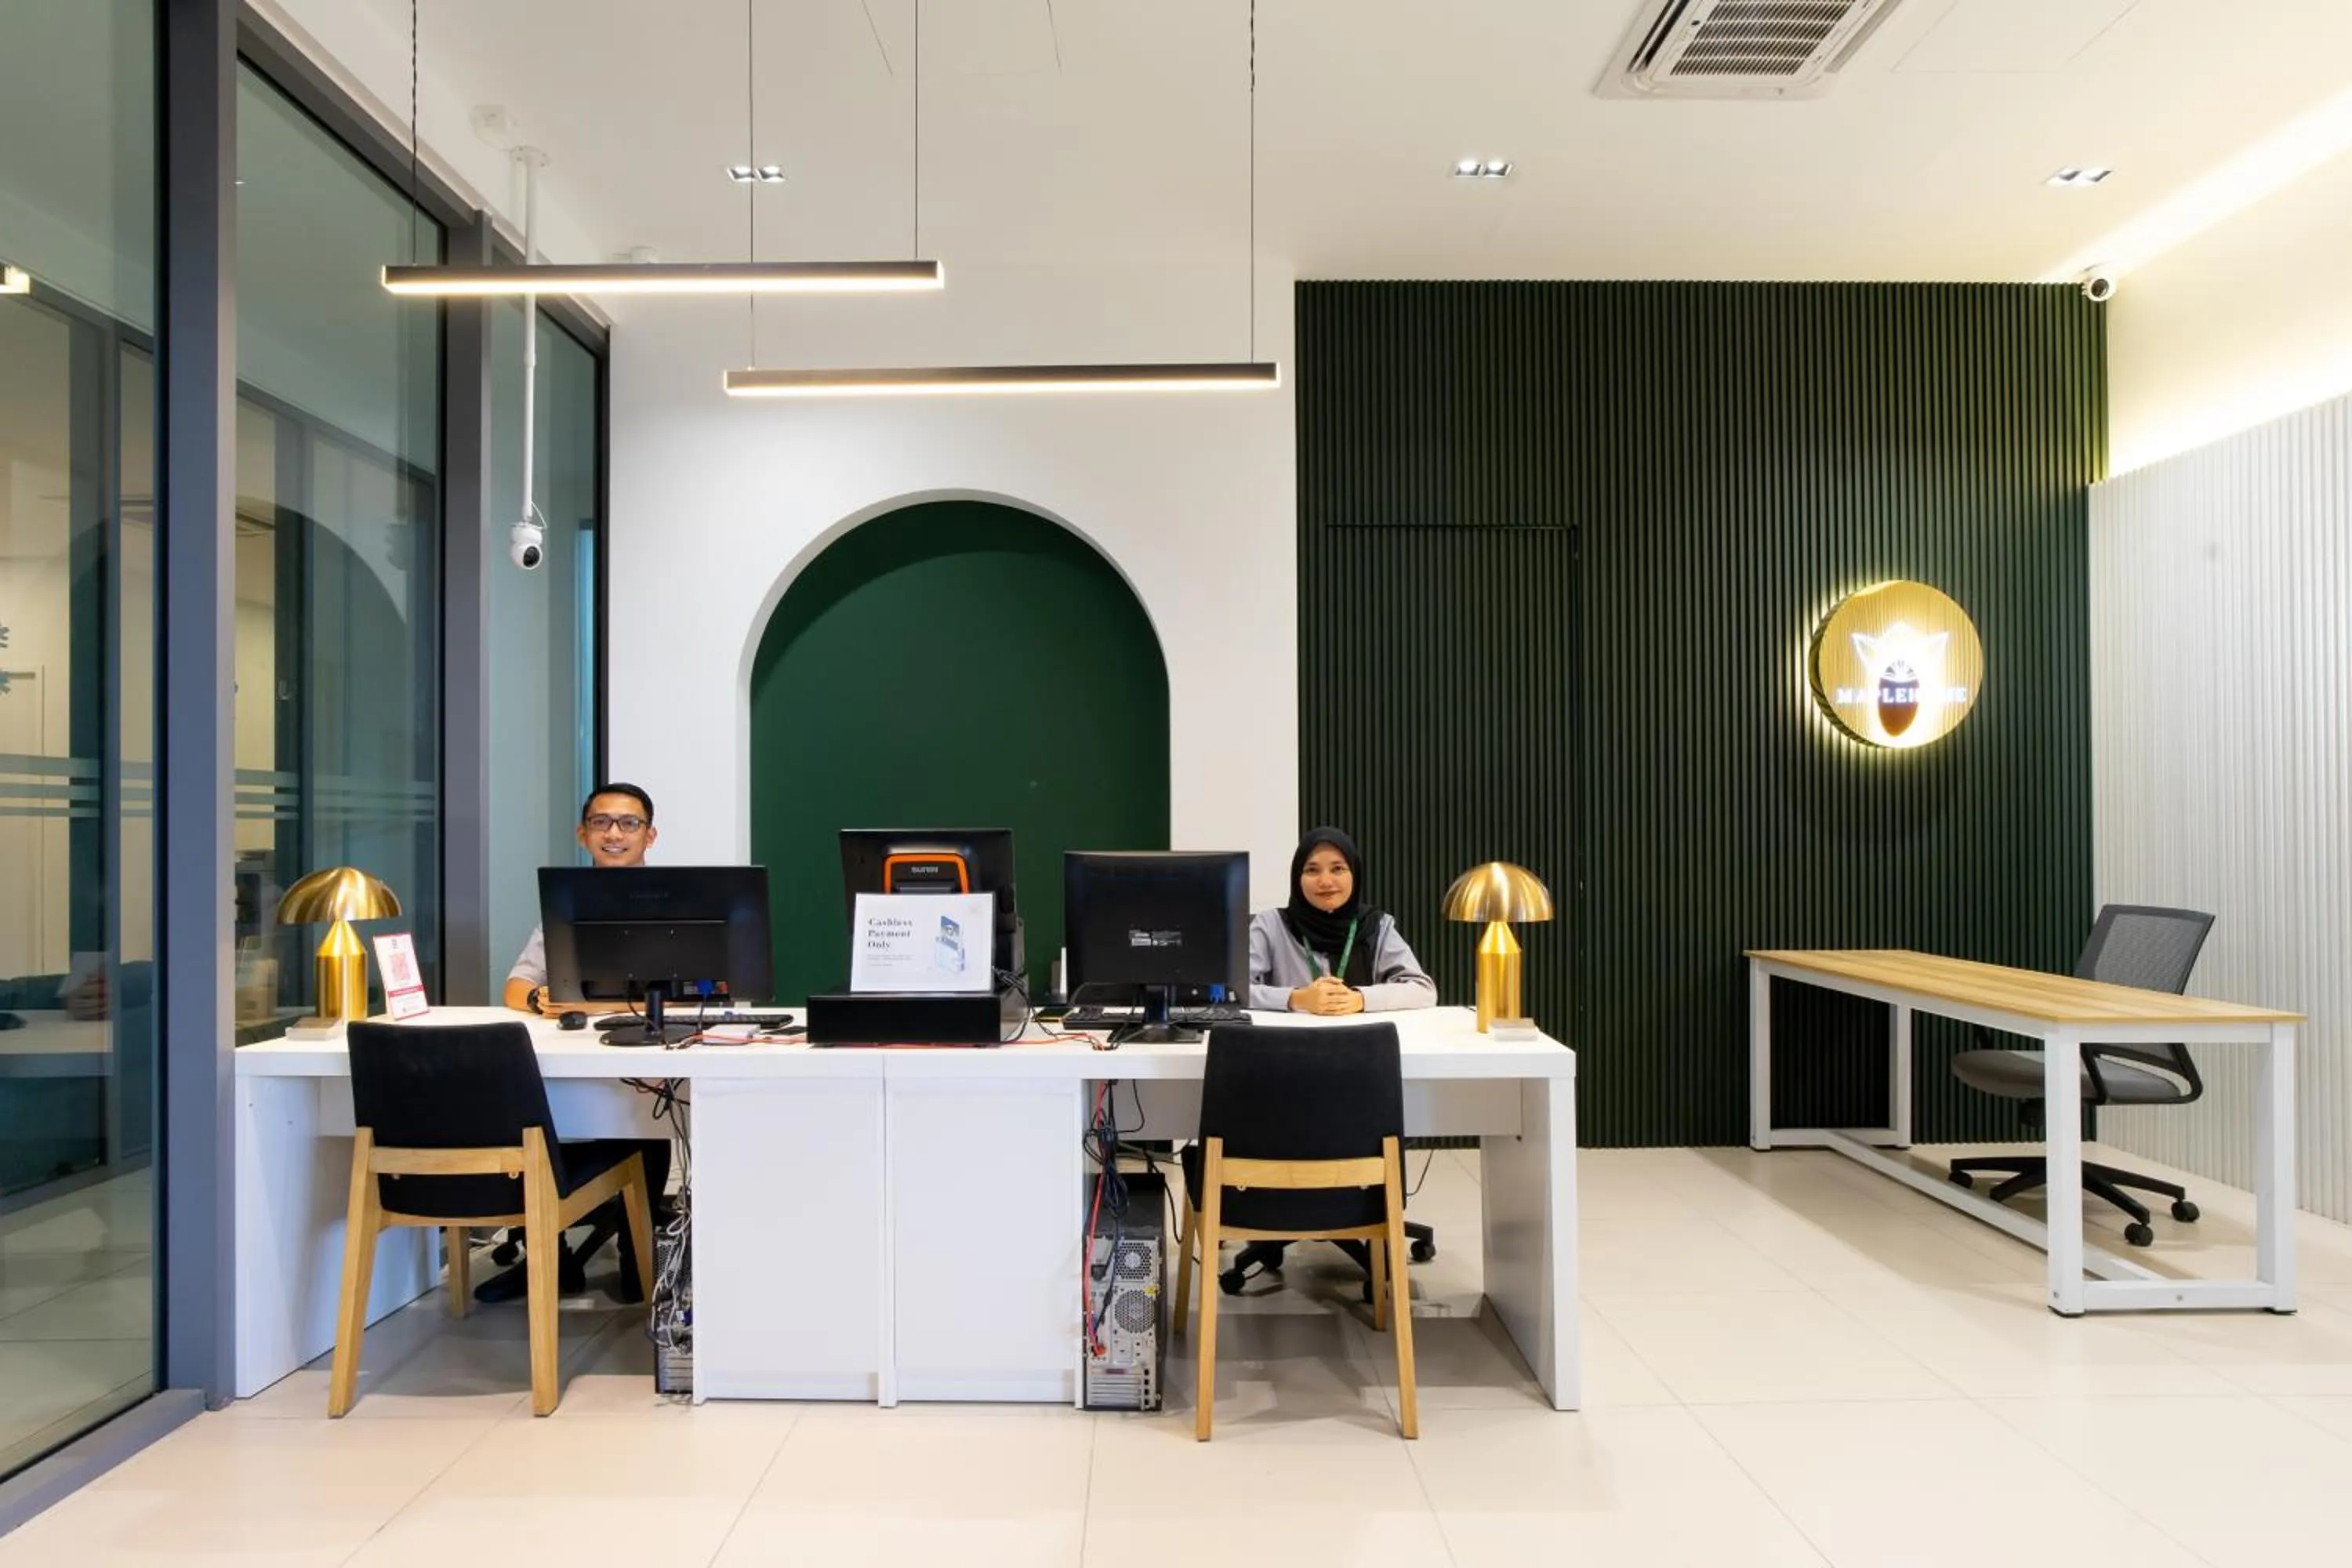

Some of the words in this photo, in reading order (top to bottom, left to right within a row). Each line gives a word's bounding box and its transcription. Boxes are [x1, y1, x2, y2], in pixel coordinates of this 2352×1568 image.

[1837, 688, 1967, 703] MALEHE
[868, 917, 912, 927] Cashless
[867, 928, 910, 938] Payment
[867, 938, 891, 950] Only
